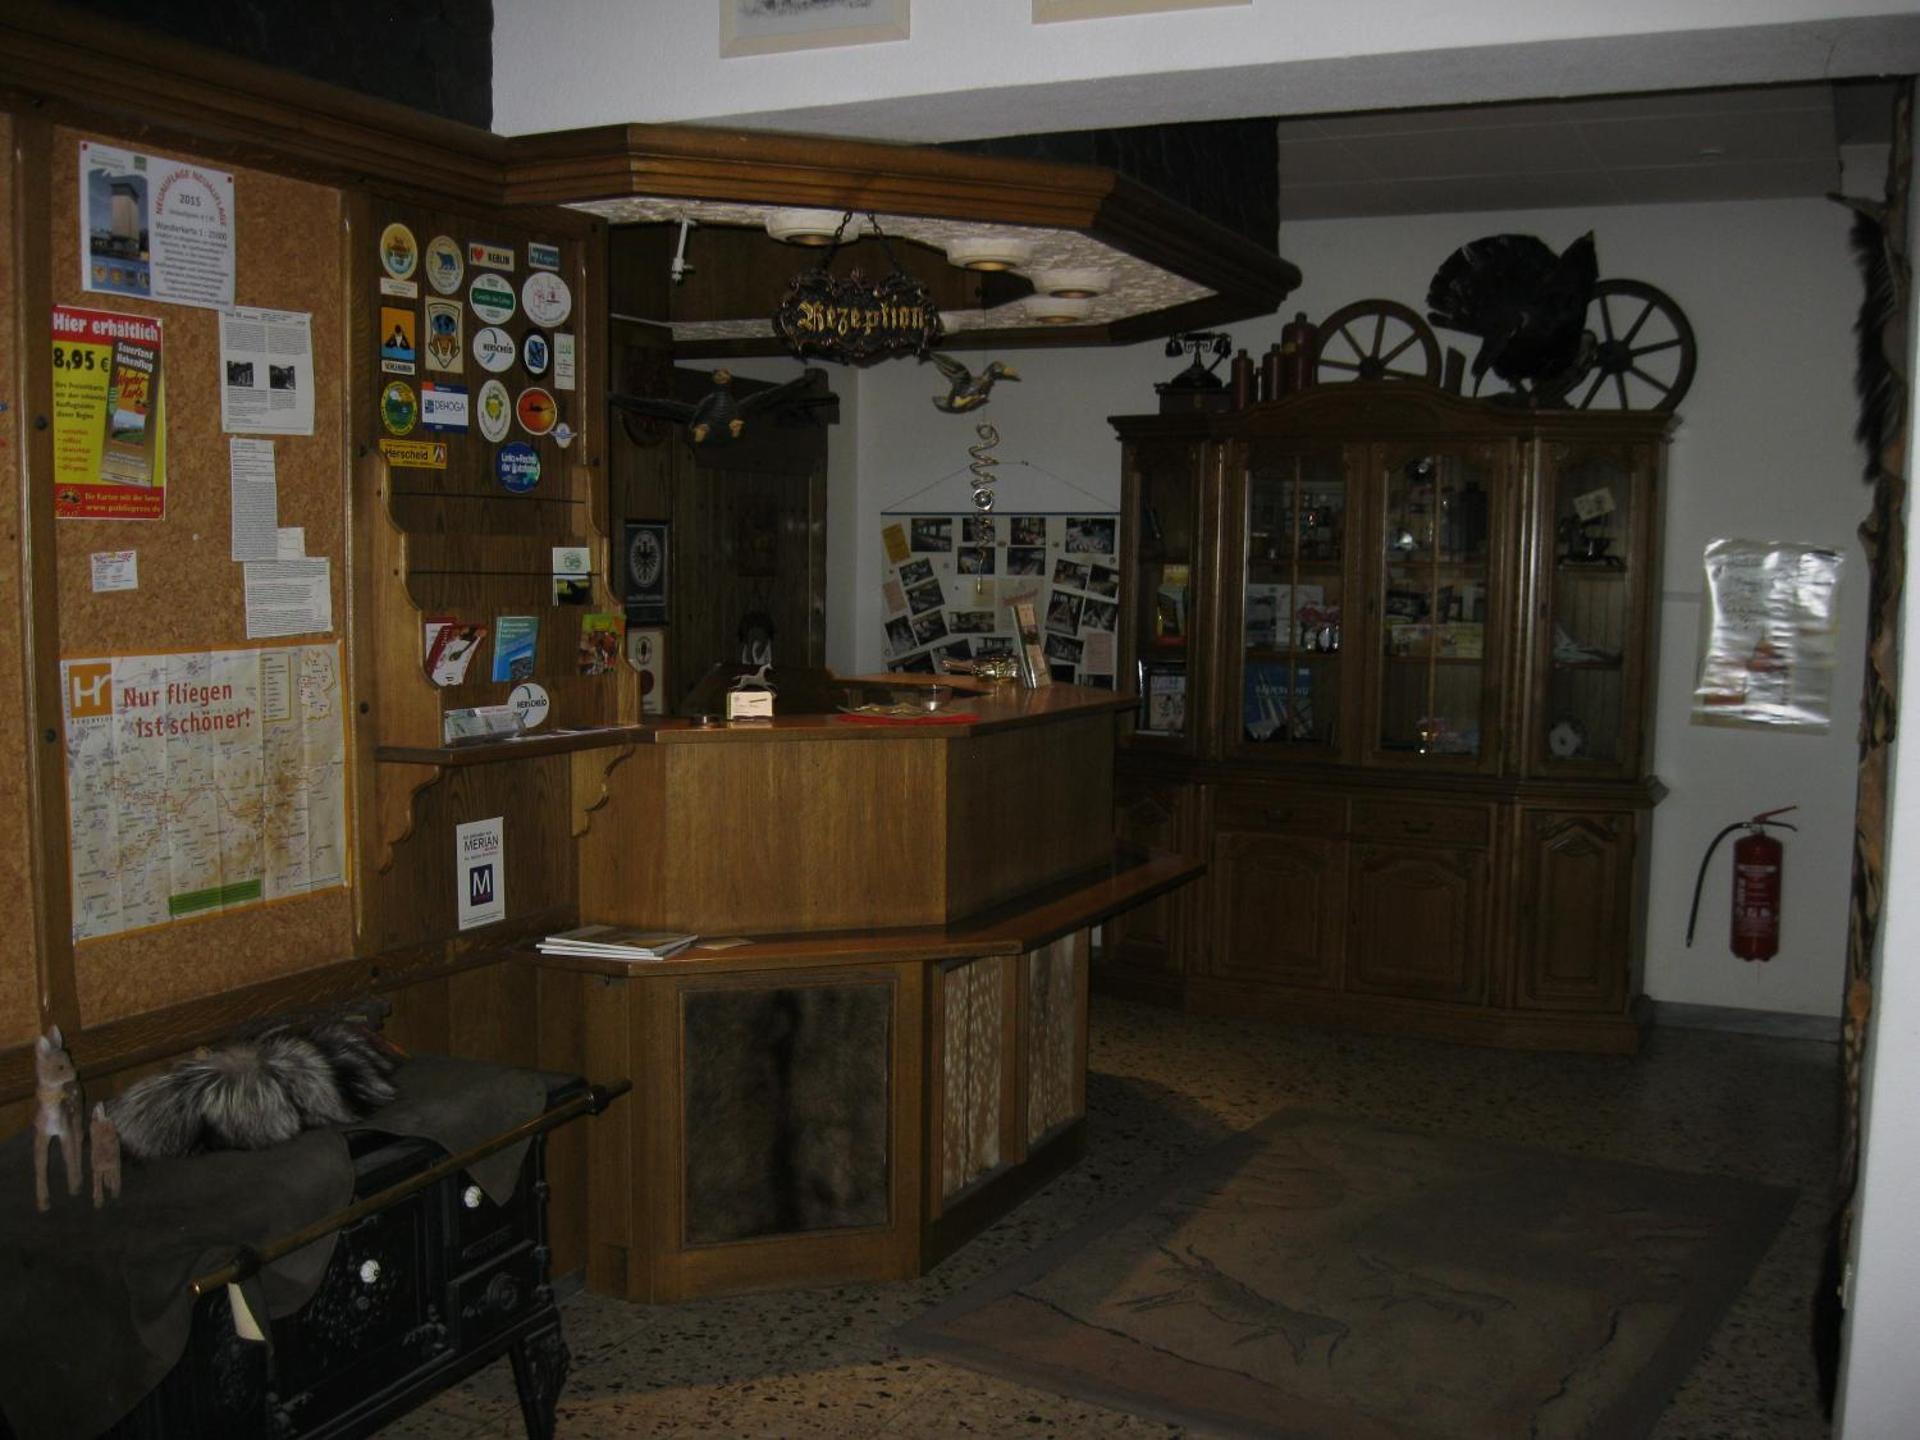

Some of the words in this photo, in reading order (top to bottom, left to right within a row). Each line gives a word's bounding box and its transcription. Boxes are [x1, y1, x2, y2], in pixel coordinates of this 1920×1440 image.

[179, 194, 202, 207] 2015
[53, 312, 87, 333] Hier
[92, 318, 160, 342] erhältlich
[797, 301, 924, 336] Rezeption
[54, 347, 95, 372] 8,95
[101, 357, 111, 373] €
[435, 400, 466, 412] DEHOGA
[385, 448, 429, 461] Herscheid
[123, 687, 160, 708] Nur
[168, 682, 232, 709] fliegen
[135, 715, 164, 739] ist
[170, 707, 252, 733] schöner!
[463, 834, 500, 852] MERIAN
[472, 868, 491, 897] M
